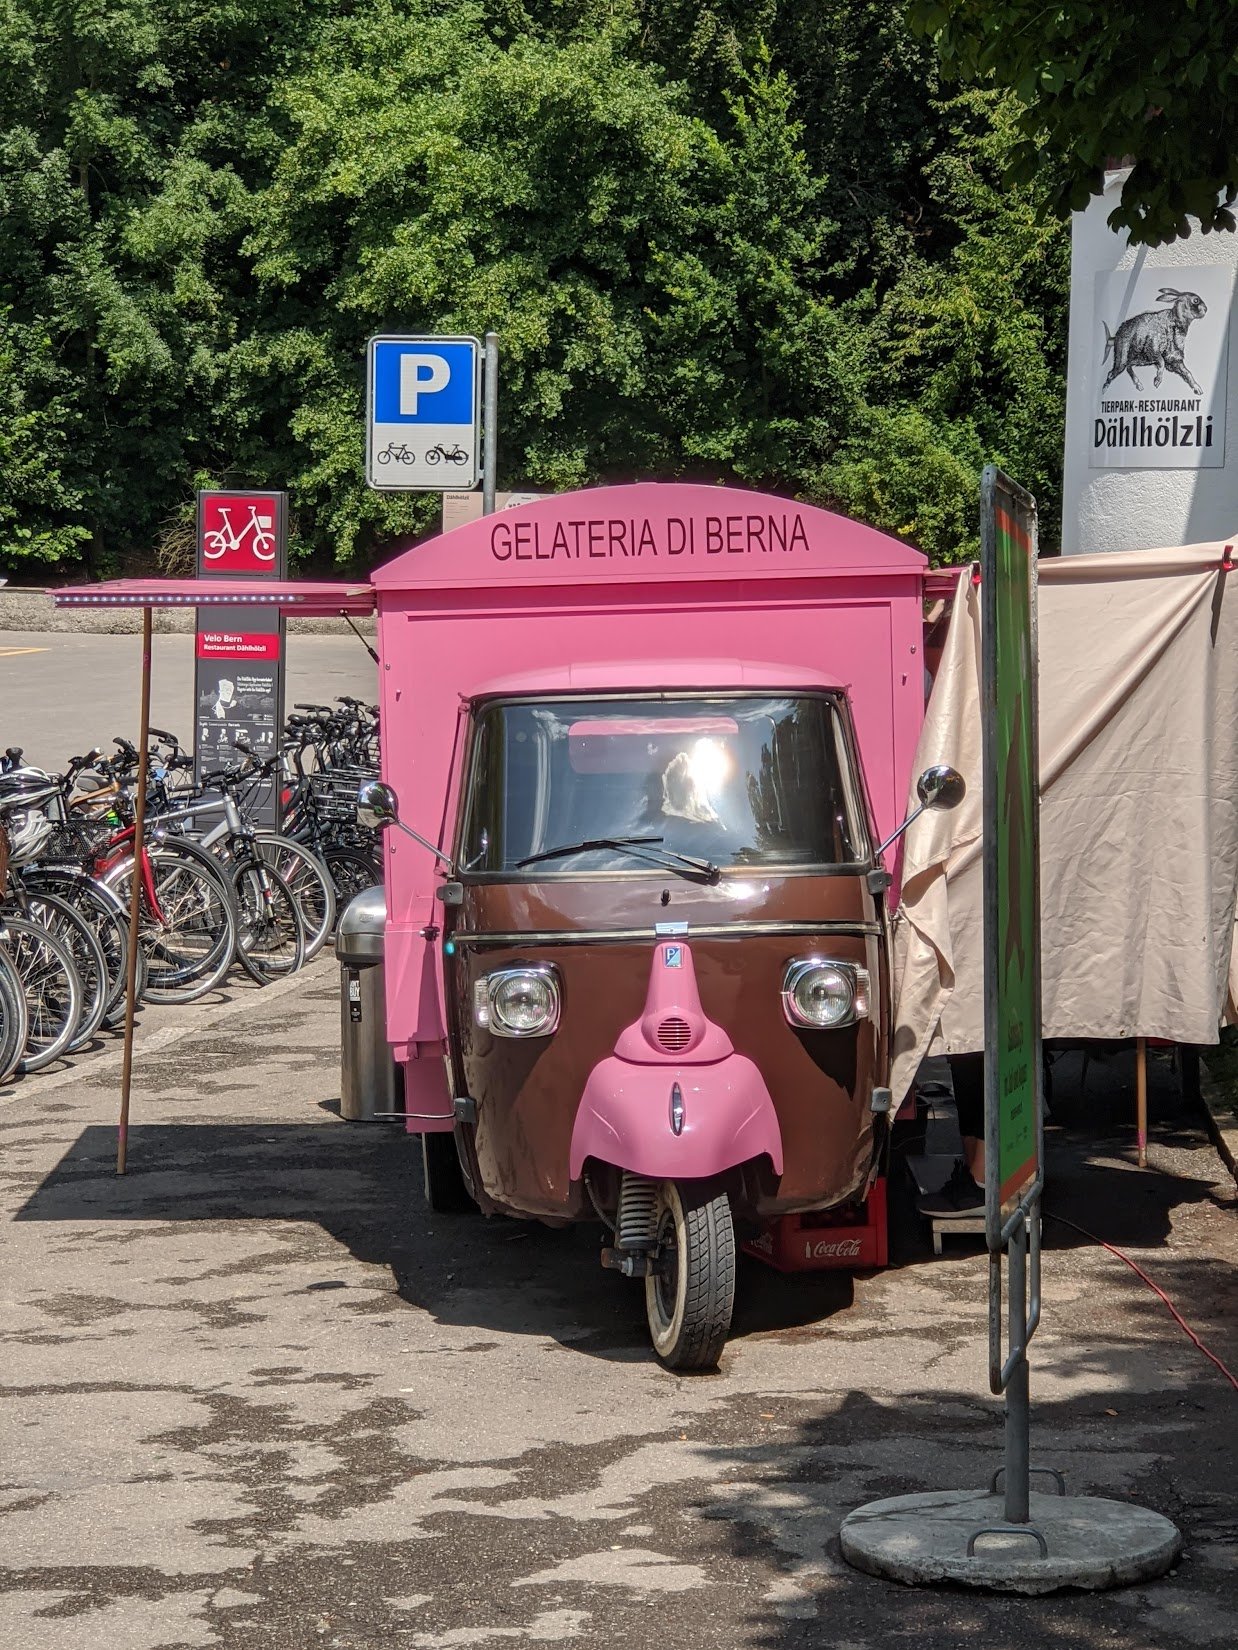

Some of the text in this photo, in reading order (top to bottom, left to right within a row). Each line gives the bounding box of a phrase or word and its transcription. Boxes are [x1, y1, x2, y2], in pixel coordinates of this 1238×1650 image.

[399, 353, 451, 416] P
[1102, 399, 1201, 413] TIERPARK-RESTAURANT
[1094, 415, 1213, 448] Dählhölzli
[490, 514, 810, 561] GELATERIA DI BERNA
[204, 634, 243, 642] Velo Bern
